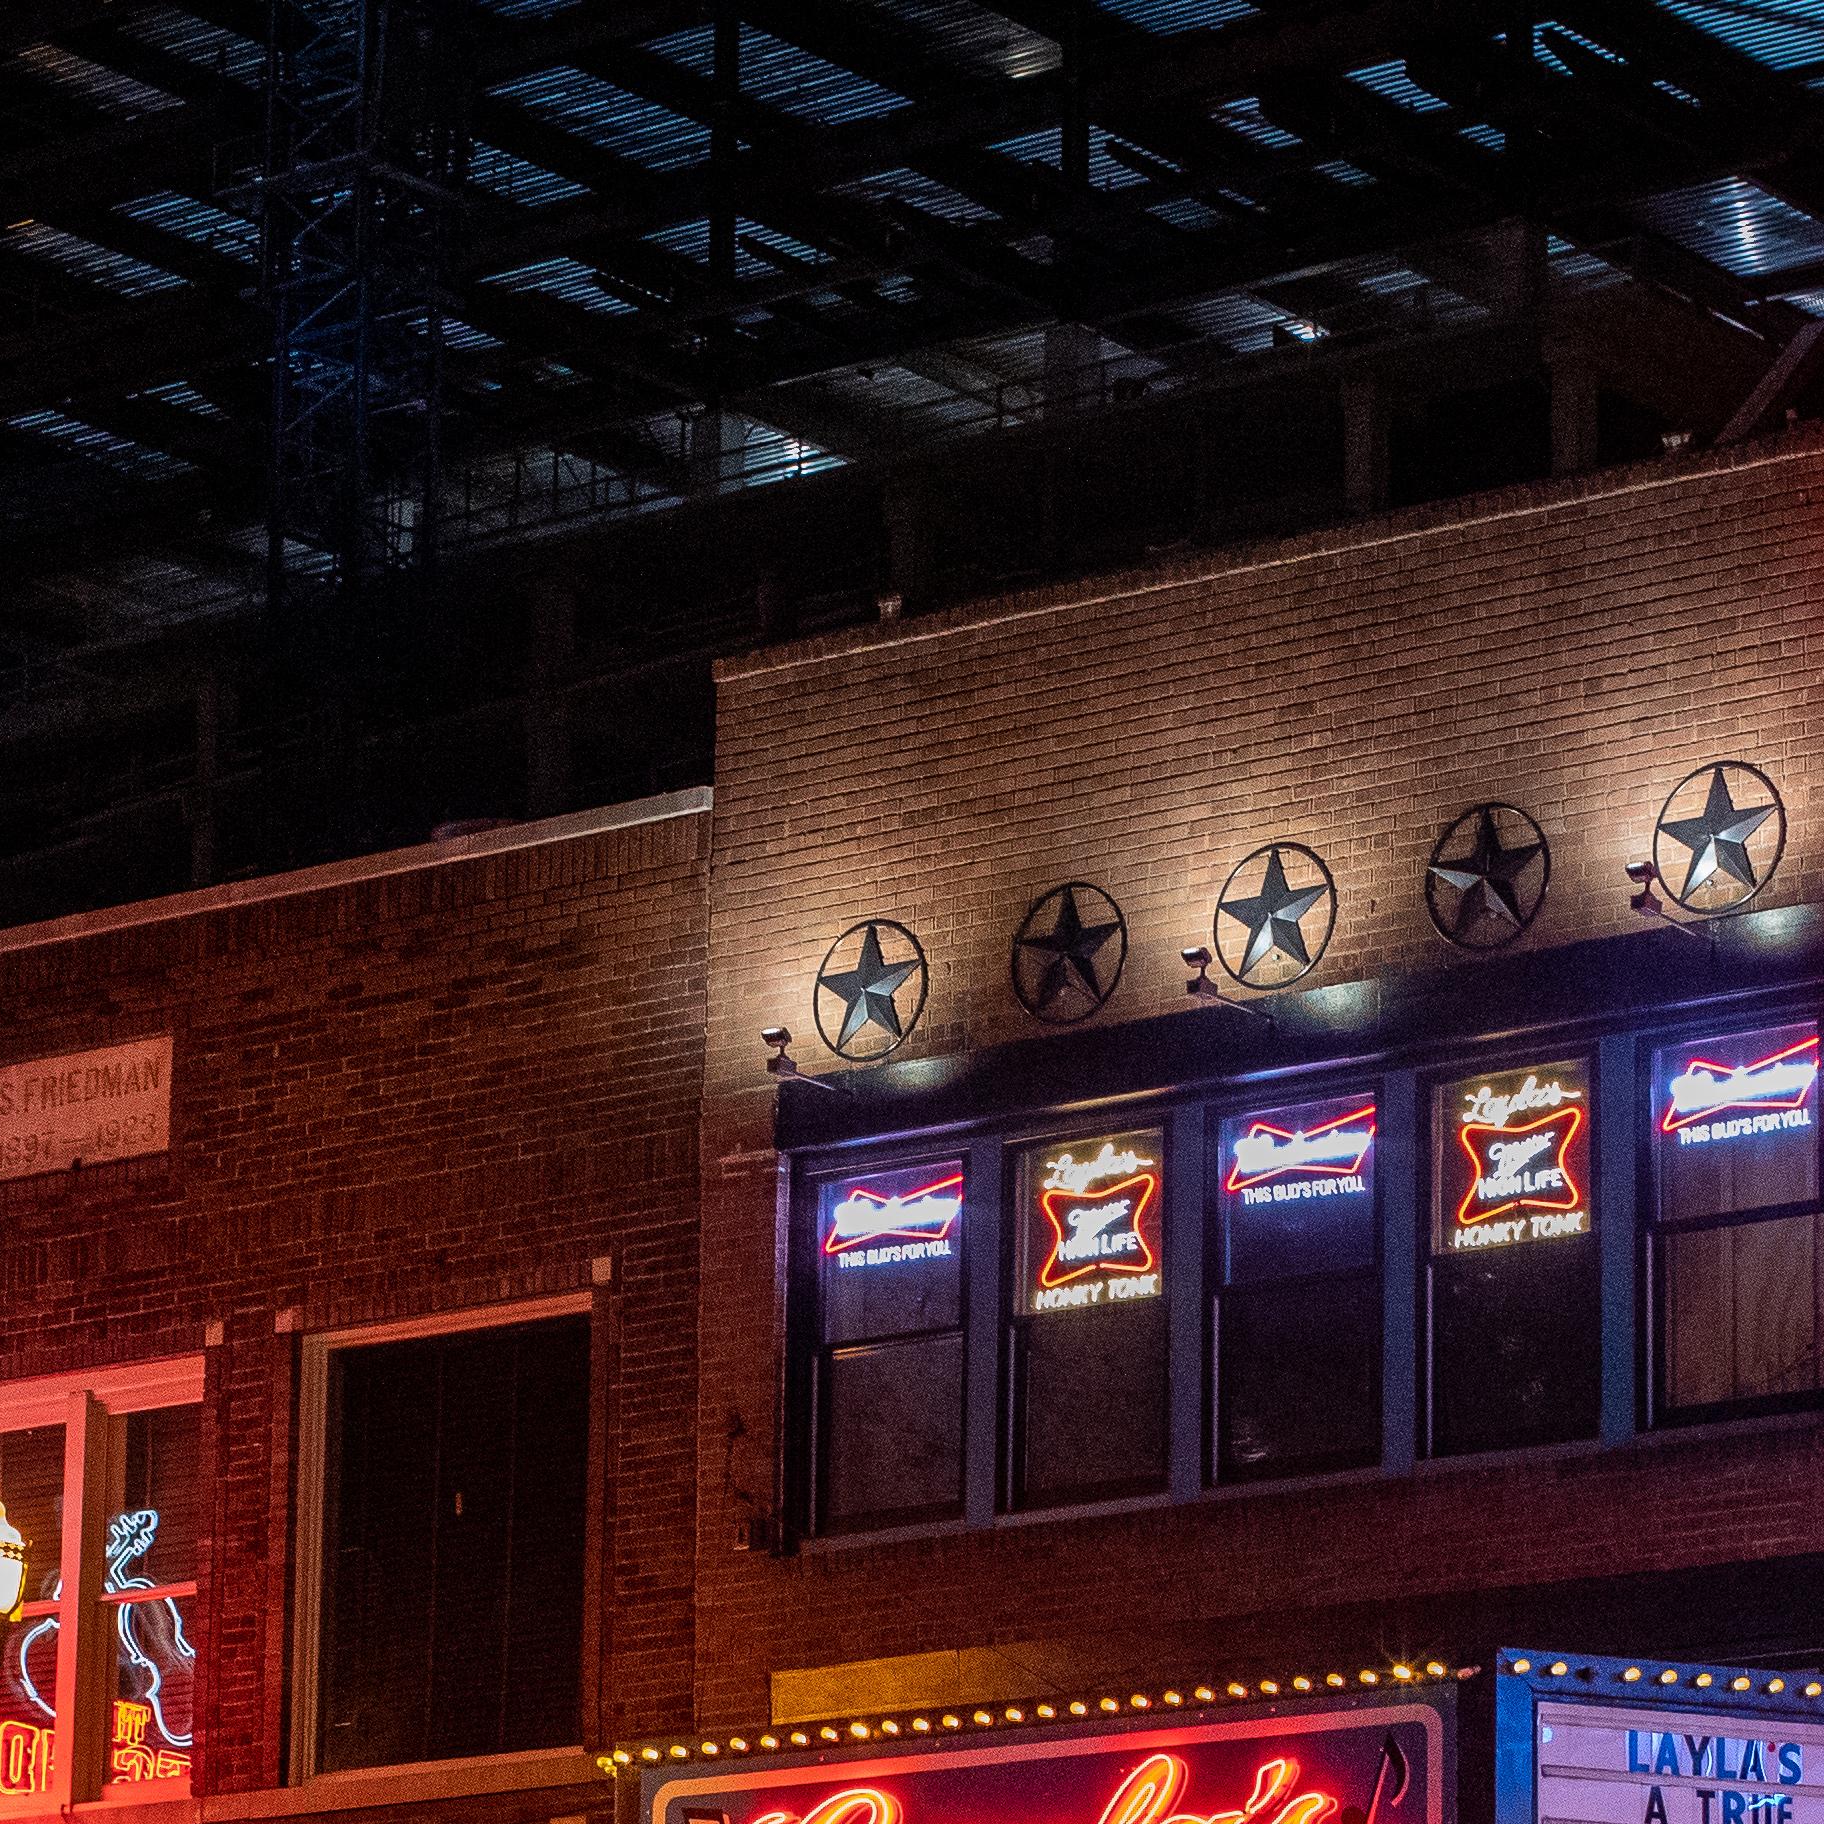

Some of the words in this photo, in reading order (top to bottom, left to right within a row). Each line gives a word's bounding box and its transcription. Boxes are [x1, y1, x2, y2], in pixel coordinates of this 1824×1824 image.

[21, 1058, 161, 1113] FRIEDMAN
[1679, 1126, 1709, 1146] THIS
[1752, 1117, 1779, 1137] FOR
[1243, 1188, 1272, 1204] THIS
[1312, 1180, 1337, 1198] FOR
[1524, 1168, 1563, 1191] LIFE
[839, 1251, 865, 1268] THIS
[902, 1242, 925, 1260] FOR
[1103, 1232, 1140, 1253] LIFE
[1627, 1729, 1803, 1785] LAYLA'S
